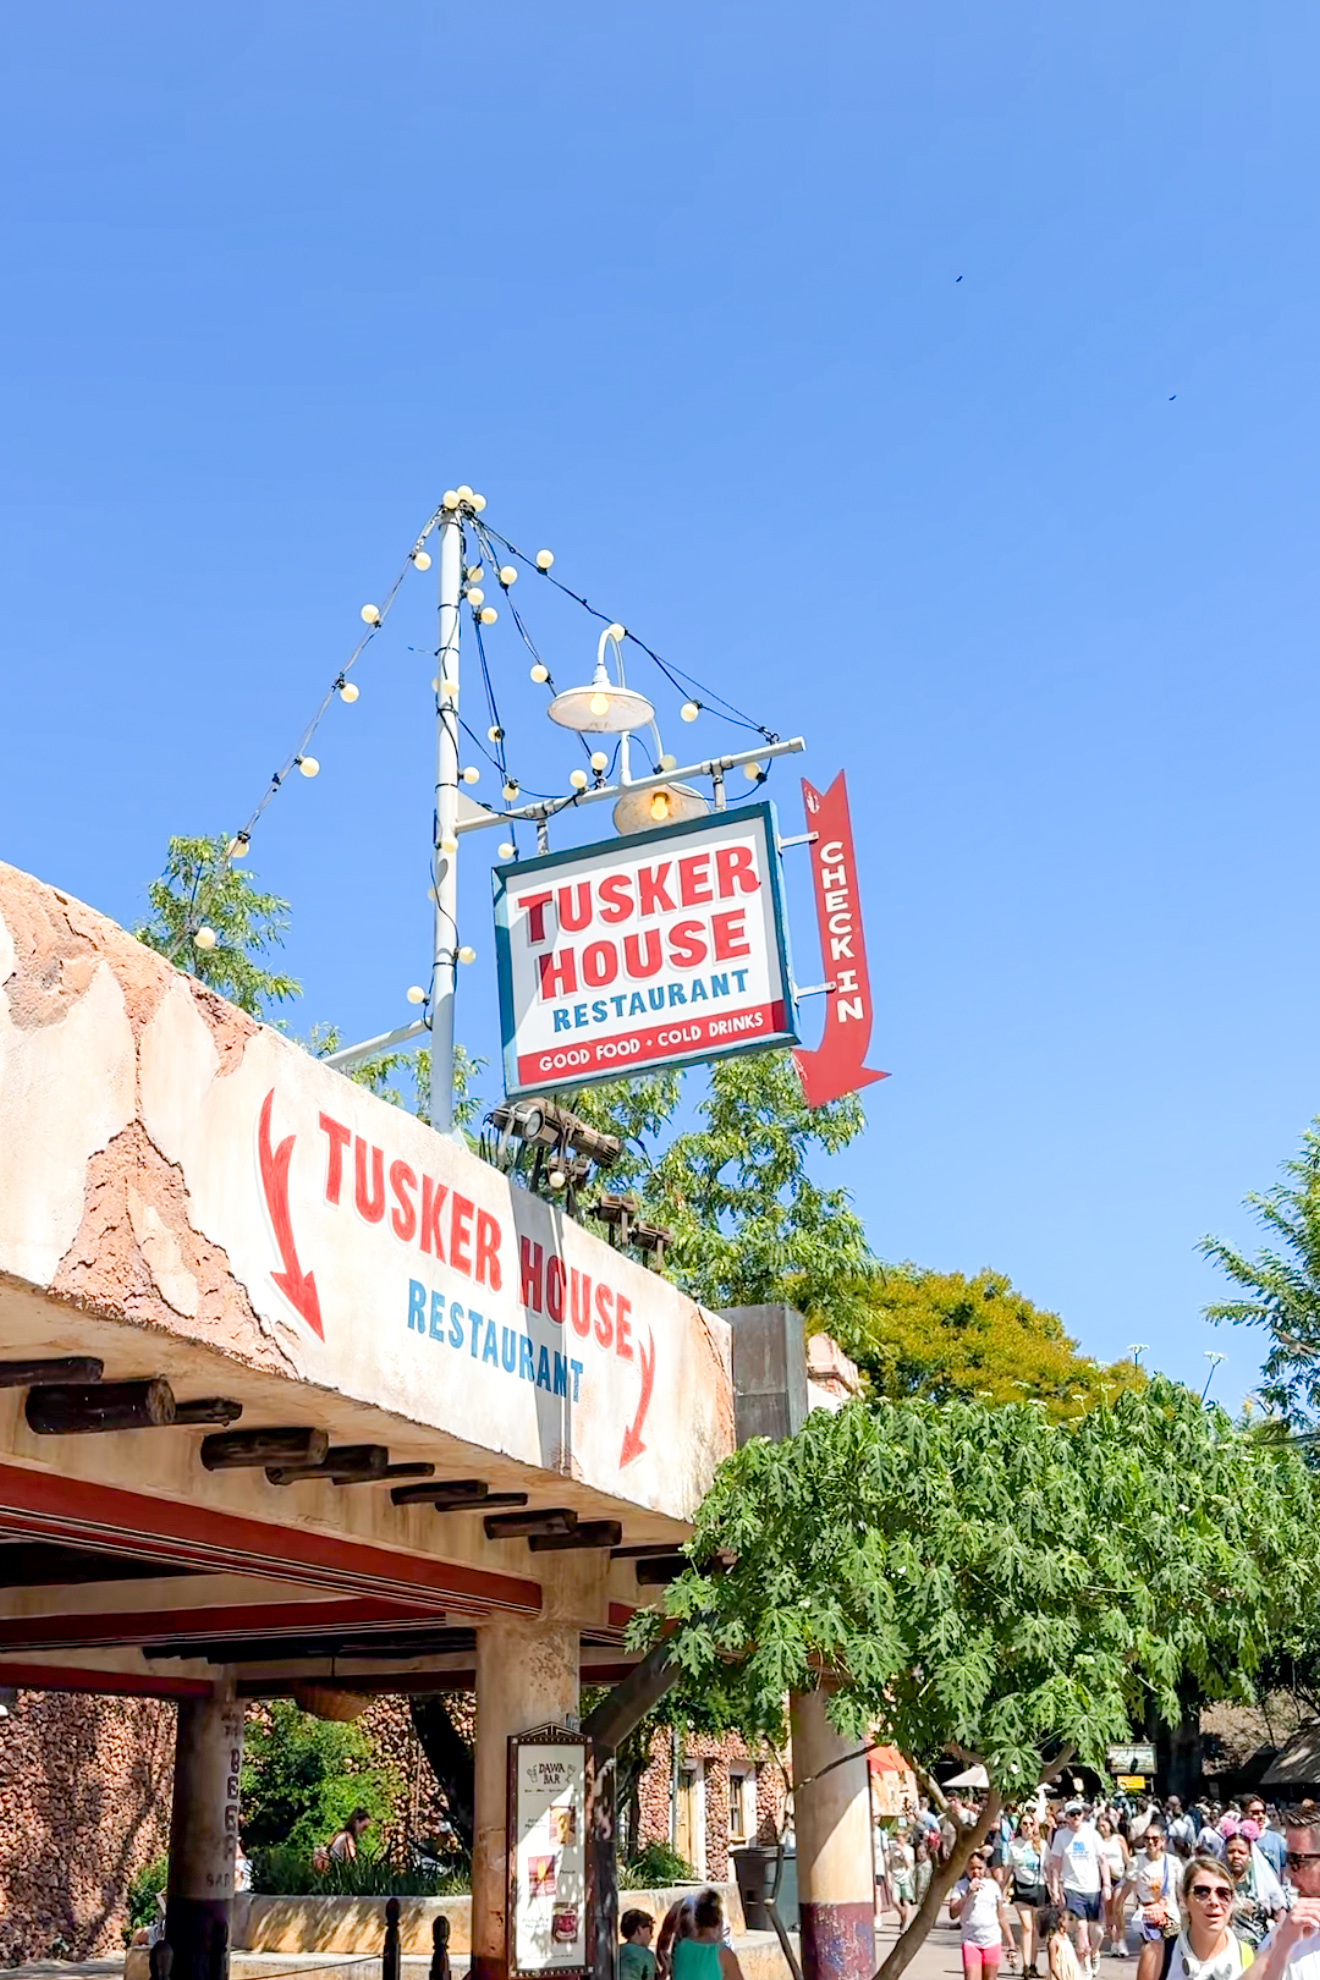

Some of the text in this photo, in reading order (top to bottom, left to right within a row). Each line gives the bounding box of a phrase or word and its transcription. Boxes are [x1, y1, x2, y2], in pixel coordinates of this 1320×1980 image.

[518, 846, 762, 945] TUSKER
[820, 841, 863, 1022] CHECK IN
[539, 908, 751, 1001] HOUSE
[553, 968, 749, 1033] RESTAURANT
[539, 1012, 764, 1072] GOOD FOOD COLD DRINKS
[318, 1110, 634, 1362] TUSKER HOUSE
[407, 1278, 584, 1403] RESTAURANT
[538, 1763, 566, 1774] DAWA
[543, 1774, 561, 1785] BAR
